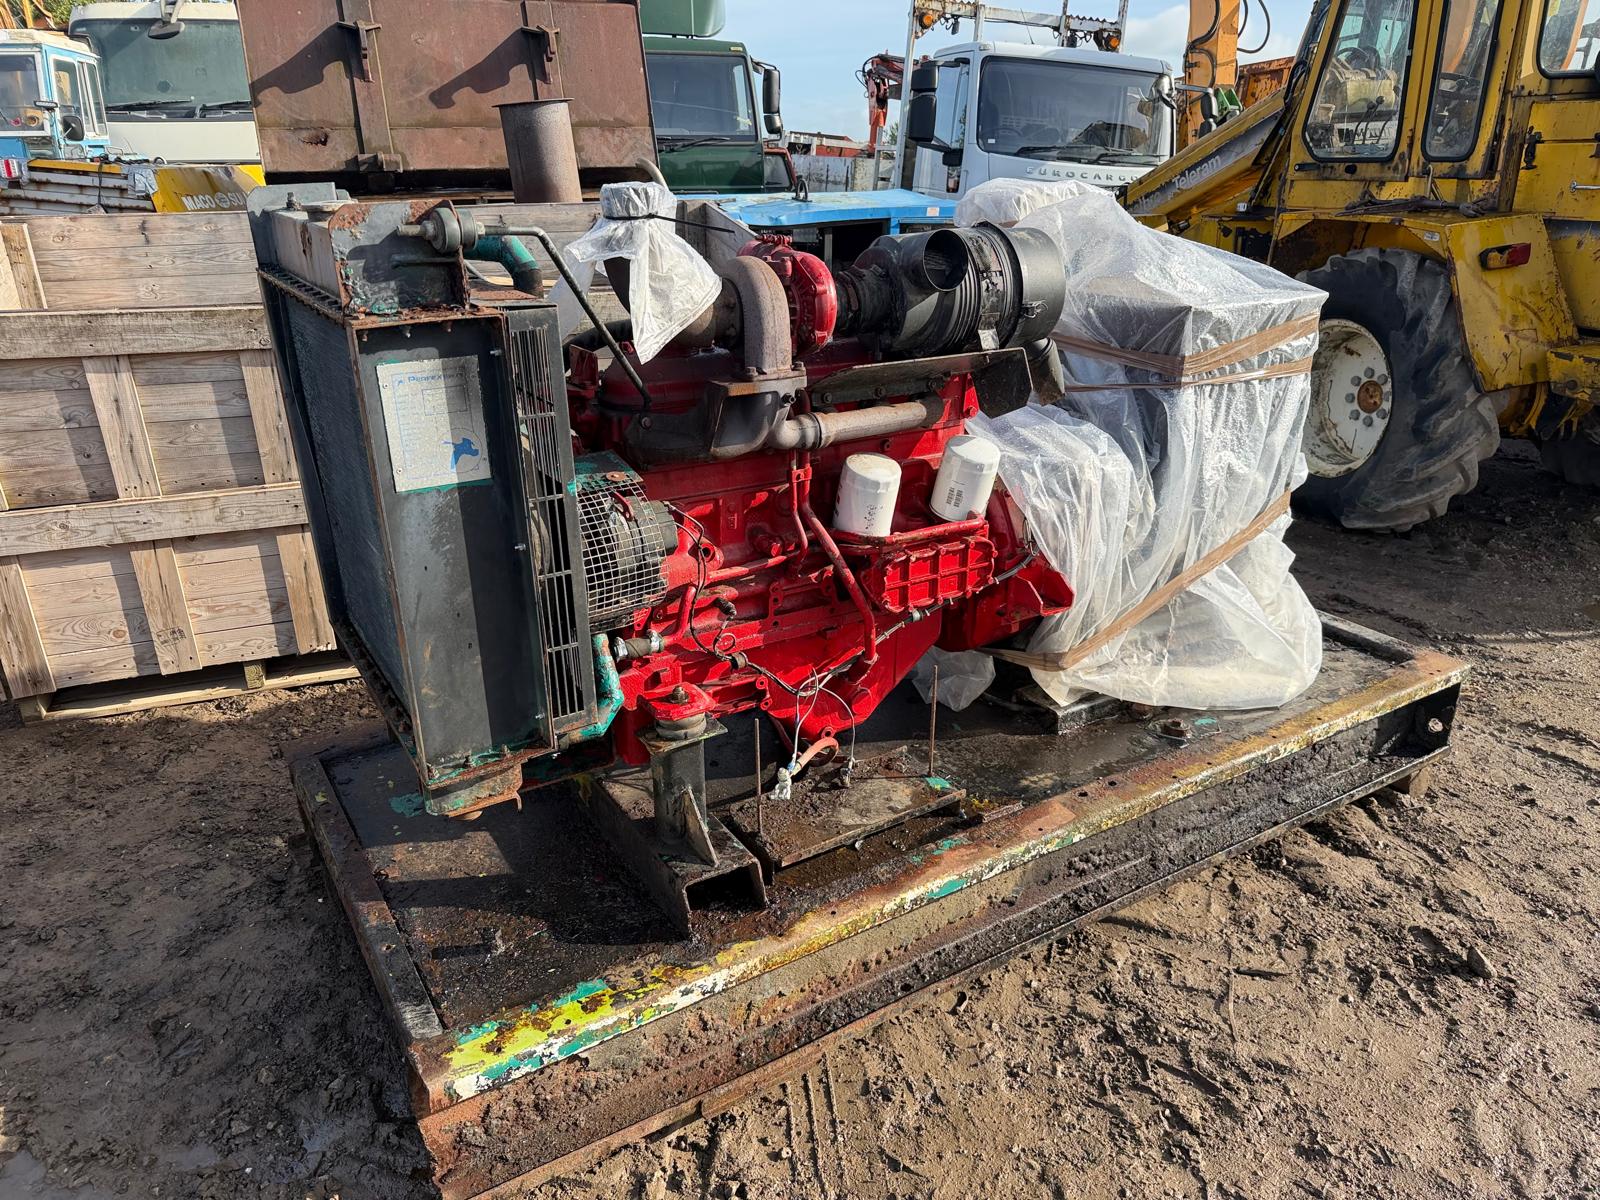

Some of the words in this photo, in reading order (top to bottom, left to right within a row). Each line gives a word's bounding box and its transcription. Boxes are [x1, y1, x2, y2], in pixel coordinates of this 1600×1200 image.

[1025, 166, 1138, 181] EUROCARGO
[1172, 155, 1221, 192] Teleram
[181, 194, 216, 211] MACO
